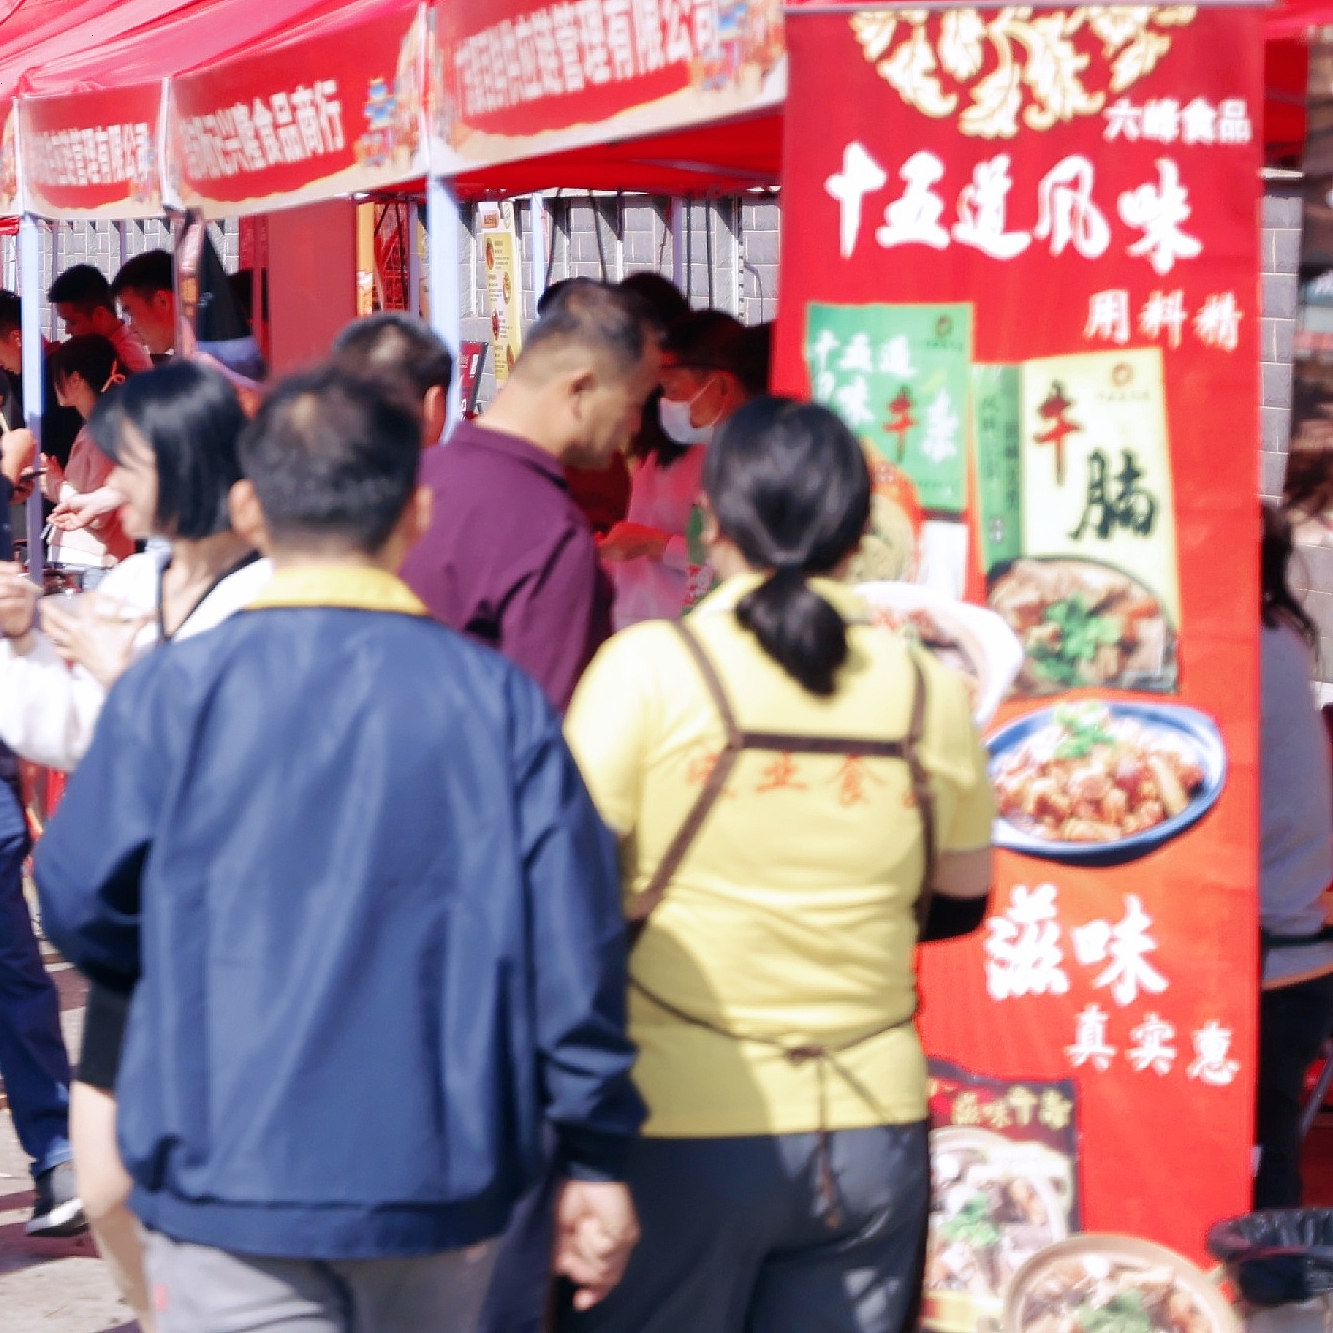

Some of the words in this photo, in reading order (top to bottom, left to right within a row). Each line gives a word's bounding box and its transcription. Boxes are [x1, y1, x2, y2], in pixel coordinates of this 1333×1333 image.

[824, 141, 1203, 275] 十五道风味
[1084, 289, 1243, 352] 用料精
[983, 881, 1171, 1007] 滋味
[1063, 1000, 1243, 1088] 真实惠
